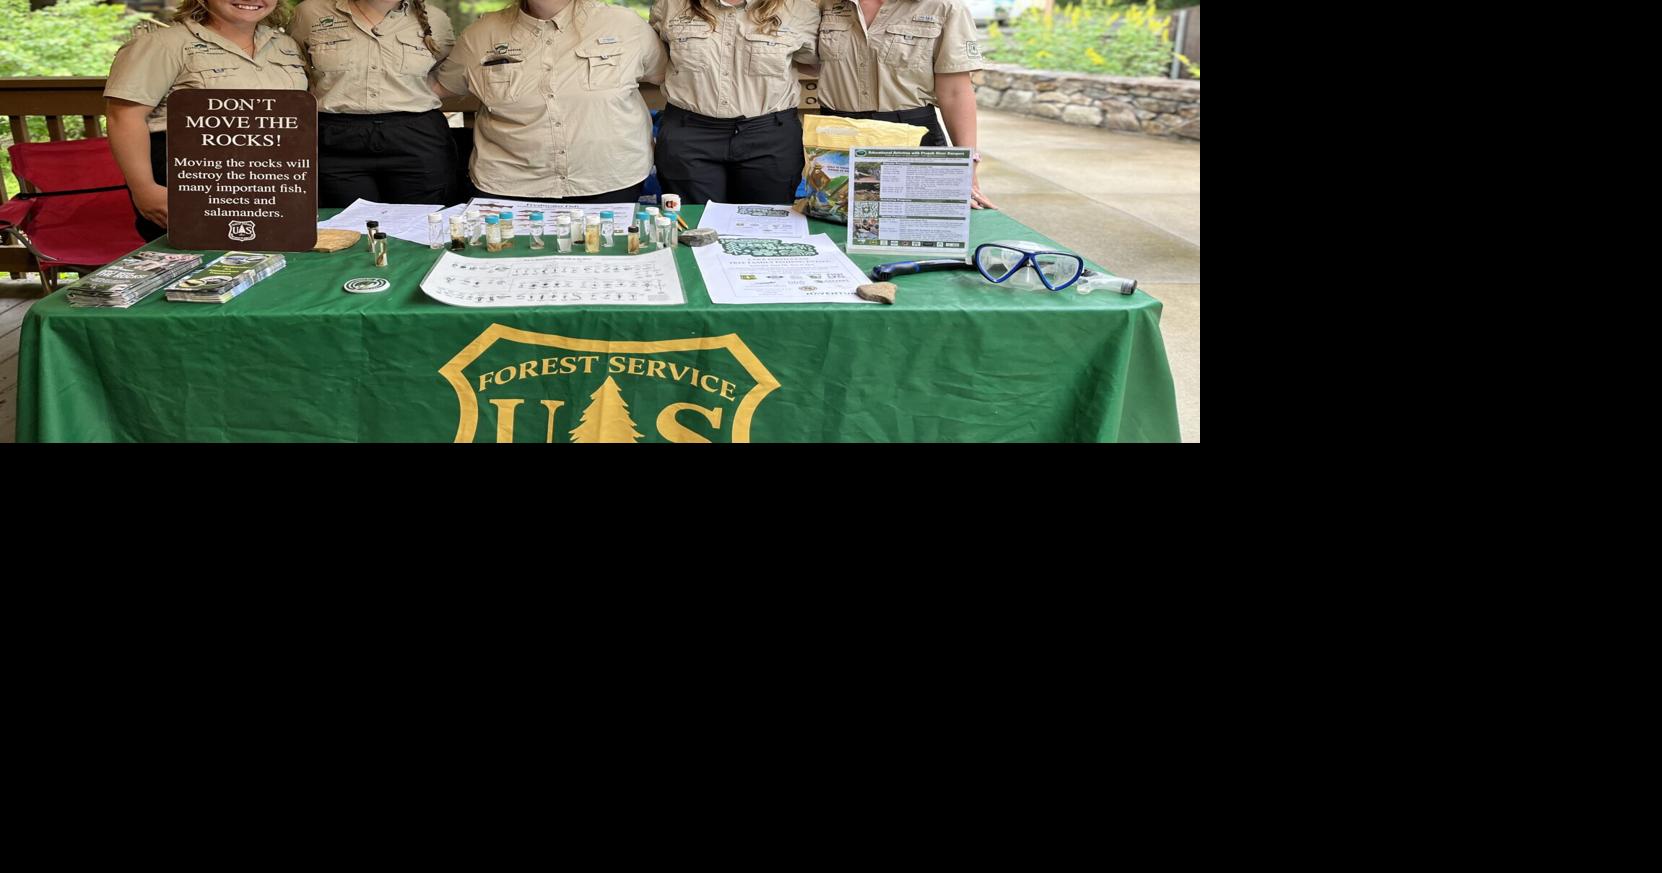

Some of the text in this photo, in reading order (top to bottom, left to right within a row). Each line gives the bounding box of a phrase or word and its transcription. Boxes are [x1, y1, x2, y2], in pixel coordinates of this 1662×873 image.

[207, 98, 276, 111] DON'T
[185, 115, 299, 129] MOVE THE
[201, 133, 281, 147] ROCKS!
[174, 157, 310, 169] Moving the rocks will
[177, 170, 308, 182] destroy the homes of
[178, 182, 307, 195] many important fish,
[208, 195, 276, 205] insects and
[203, 207, 284, 218] salamanders.
[478, 355, 737, 402] FOREST SERVICE
